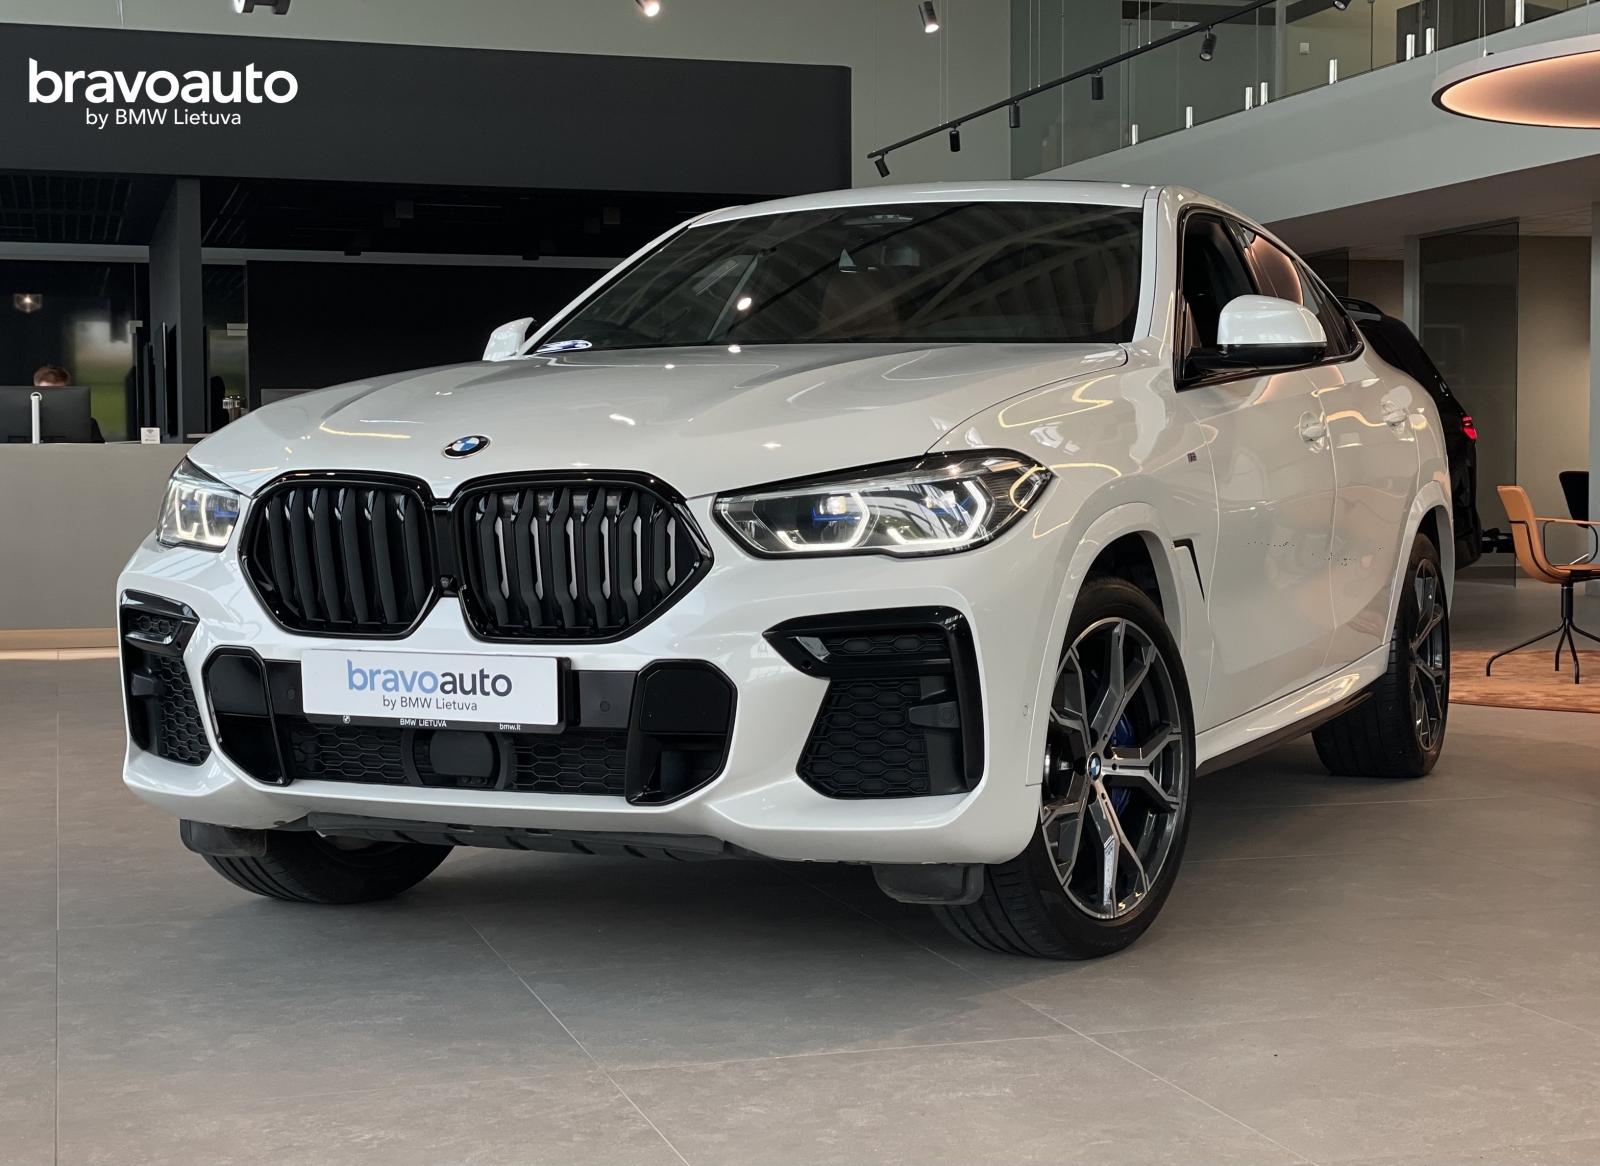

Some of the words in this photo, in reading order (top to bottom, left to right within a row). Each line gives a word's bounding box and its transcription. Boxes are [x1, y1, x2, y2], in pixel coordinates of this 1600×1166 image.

[346, 659, 512, 697] bravoauto
[382, 695, 397, 711] by
[400, 696, 432, 709] BMW
[435, 698, 477, 711] Lietuva
[400, 718, 416, 726] BMW
[418, 719, 447, 728] LIETUVA
[499, 723, 521, 731] bmw.lt
